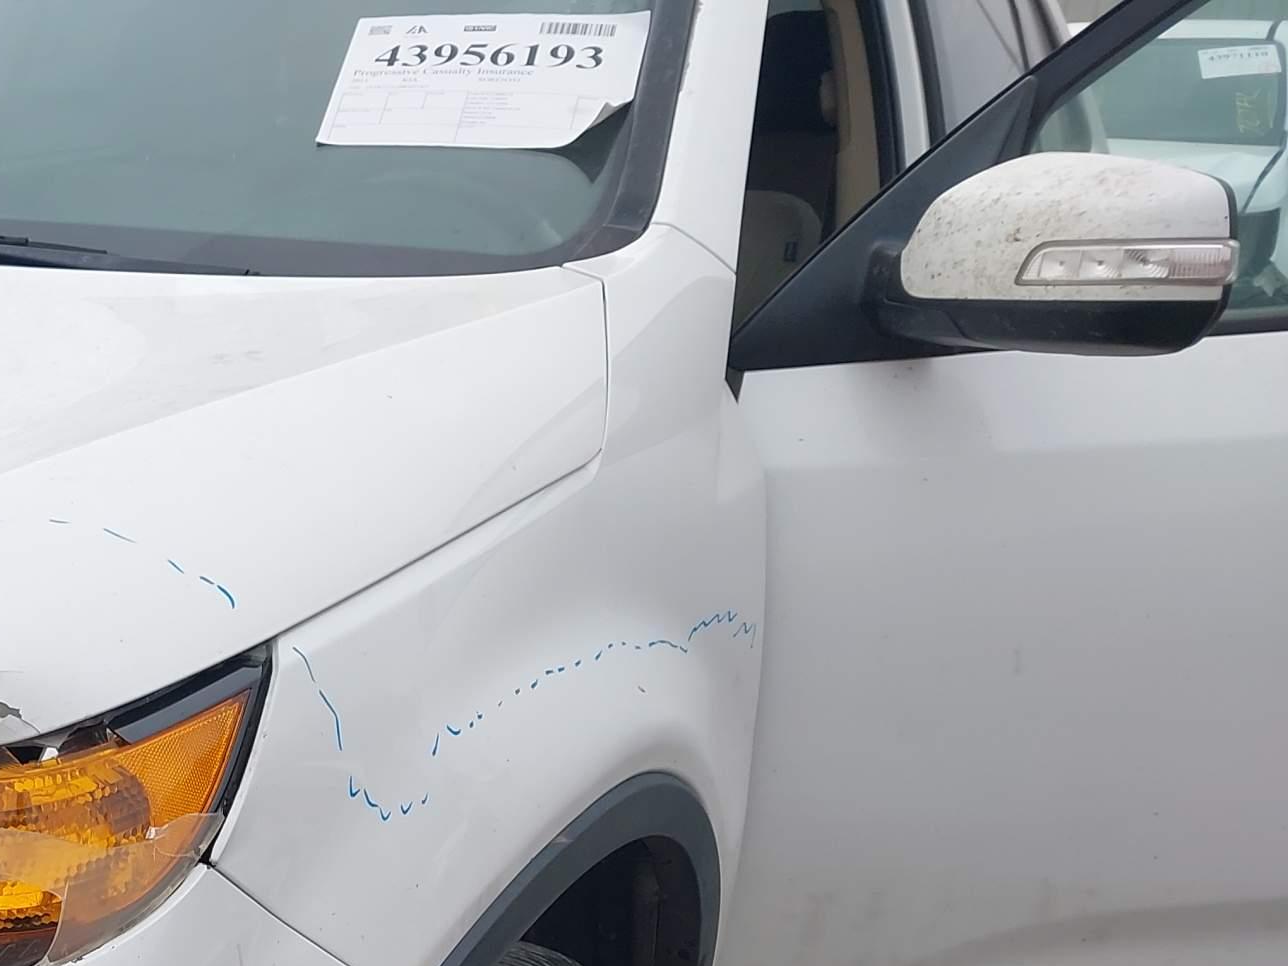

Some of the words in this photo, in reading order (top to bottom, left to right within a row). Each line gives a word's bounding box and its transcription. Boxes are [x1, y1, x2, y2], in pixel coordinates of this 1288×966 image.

[374, 43, 604, 69] 43956193
[353, 69, 419, 78] Progressive
[423, 68, 472, 76] Casualty
[477, 68, 535, 76] Insurance
